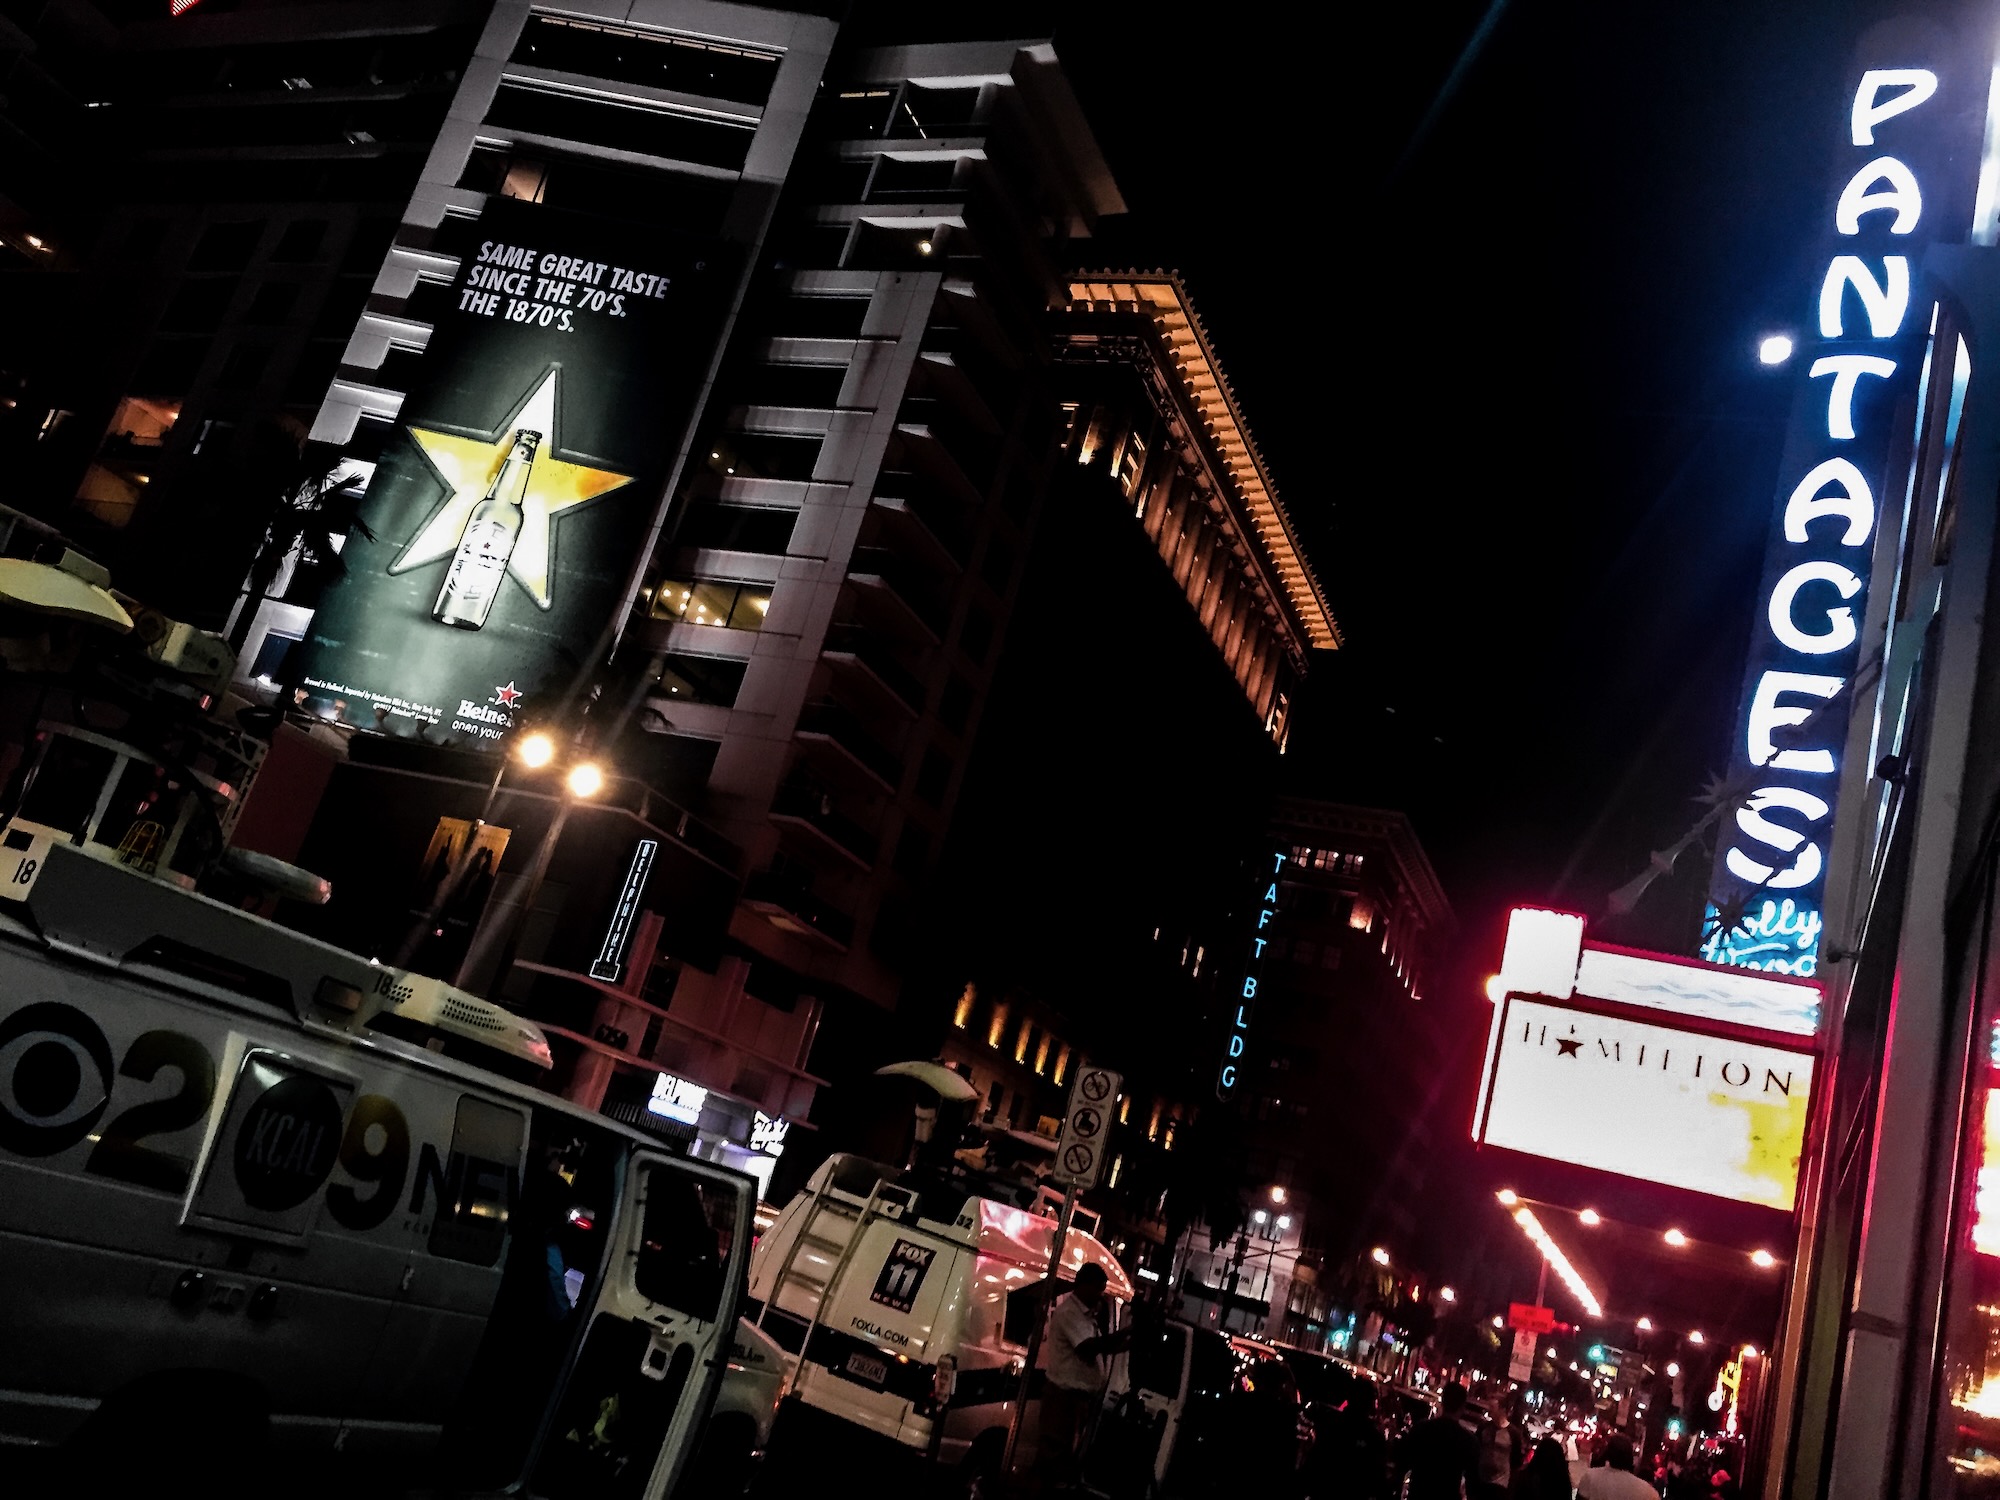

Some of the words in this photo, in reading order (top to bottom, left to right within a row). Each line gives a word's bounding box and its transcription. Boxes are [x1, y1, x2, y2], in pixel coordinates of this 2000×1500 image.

[466, 264, 531, 296] SINCE
[534, 277, 576, 305] THE
[576, 286, 627, 318] 70'S.
[477, 240, 537, 271] SAME
[539, 253, 608, 285] GREAT
[609, 266, 671, 299] TASTE
[459, 288, 501, 317] THE
[504, 298, 575, 333] 1870'S.
[1727, 69, 1938, 889] PANTAGES
[12, 858, 37, 884] 18
[1255, 853, 1286, 958] TAFT
[373, 972, 394, 996] 18
[1222, 976, 1257, 1088] BLDG
[85, 1030, 215, 1195] 2
[246, 1107, 326, 1177] KCAL
[326, 1094, 411, 1231] 9
[957, 1214, 974, 1230] 32
[897, 1241, 931, 1267] FOX
[885, 1261, 918, 1299] 11
[851, 1317, 910, 1347] FOXLA.COM
